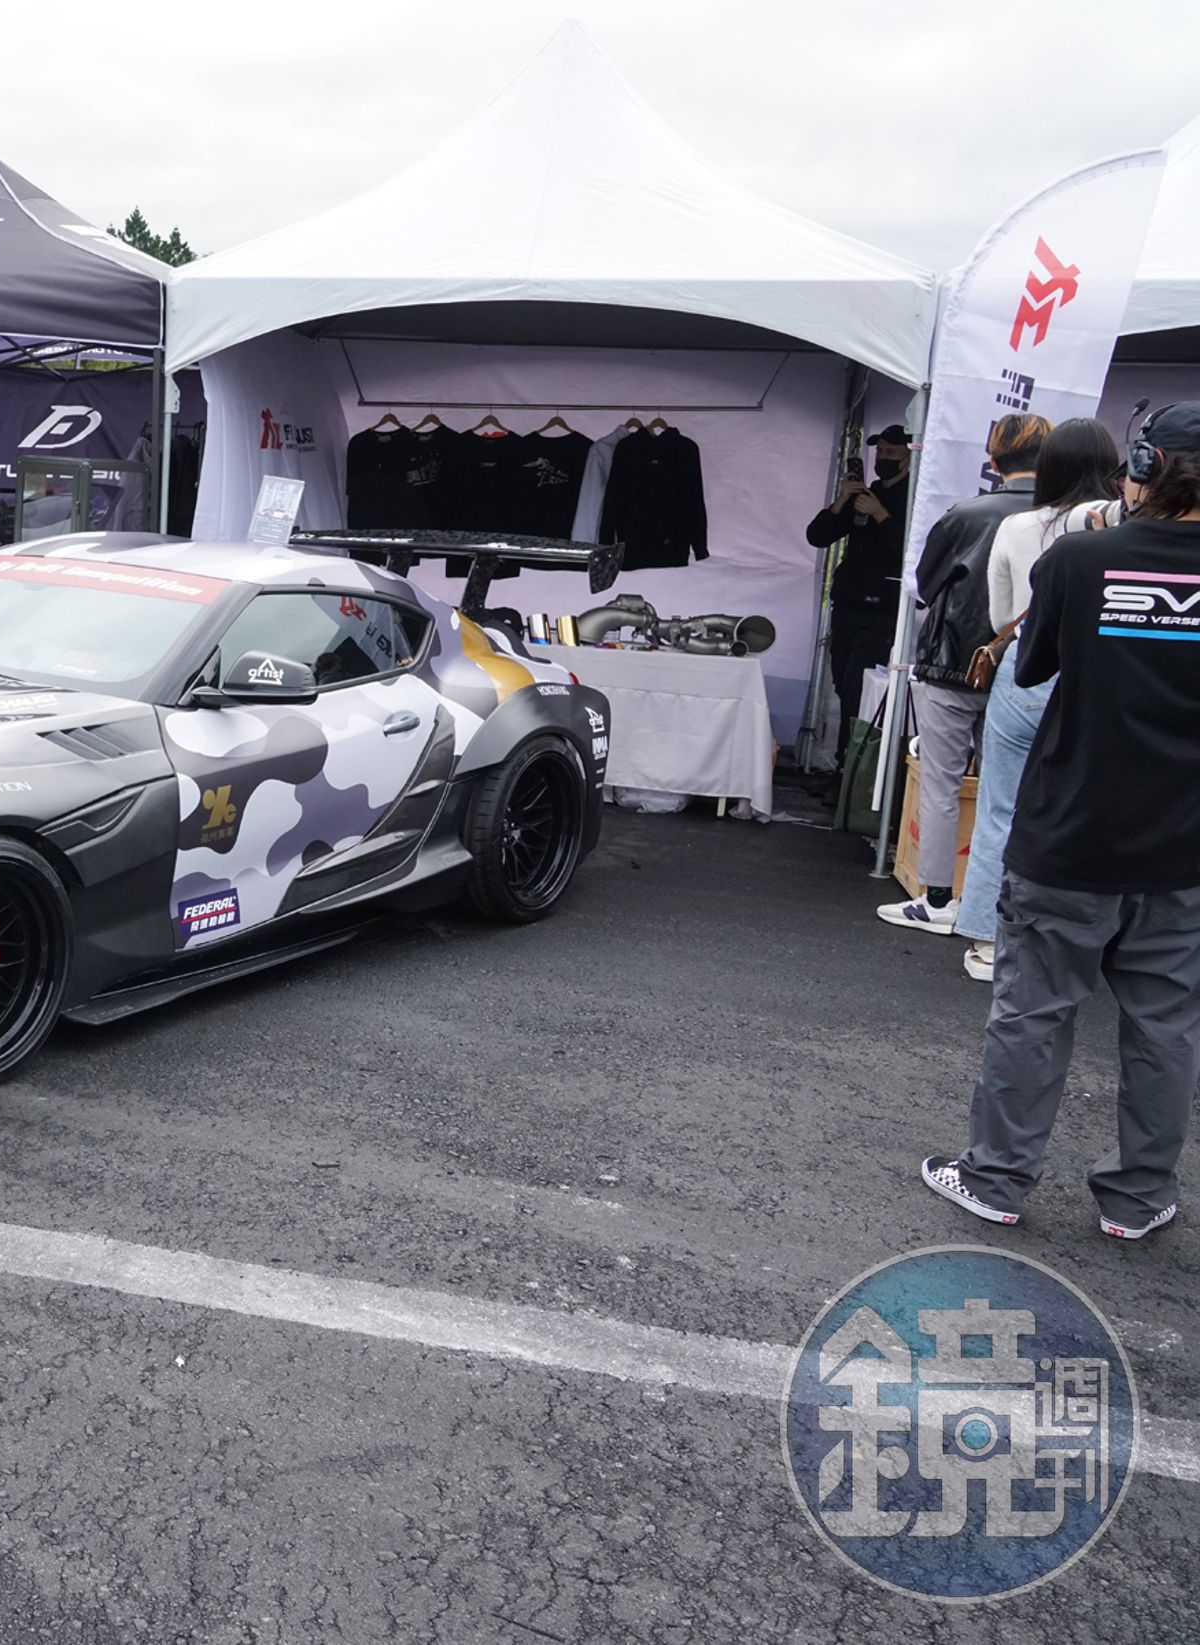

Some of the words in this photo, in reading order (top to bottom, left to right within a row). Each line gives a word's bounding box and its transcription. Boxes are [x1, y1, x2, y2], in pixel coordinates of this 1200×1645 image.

[1099, 612, 1147, 623] SPEED
[247, 667, 285, 679] artist
[183, 897, 235, 920] FEDERAL
